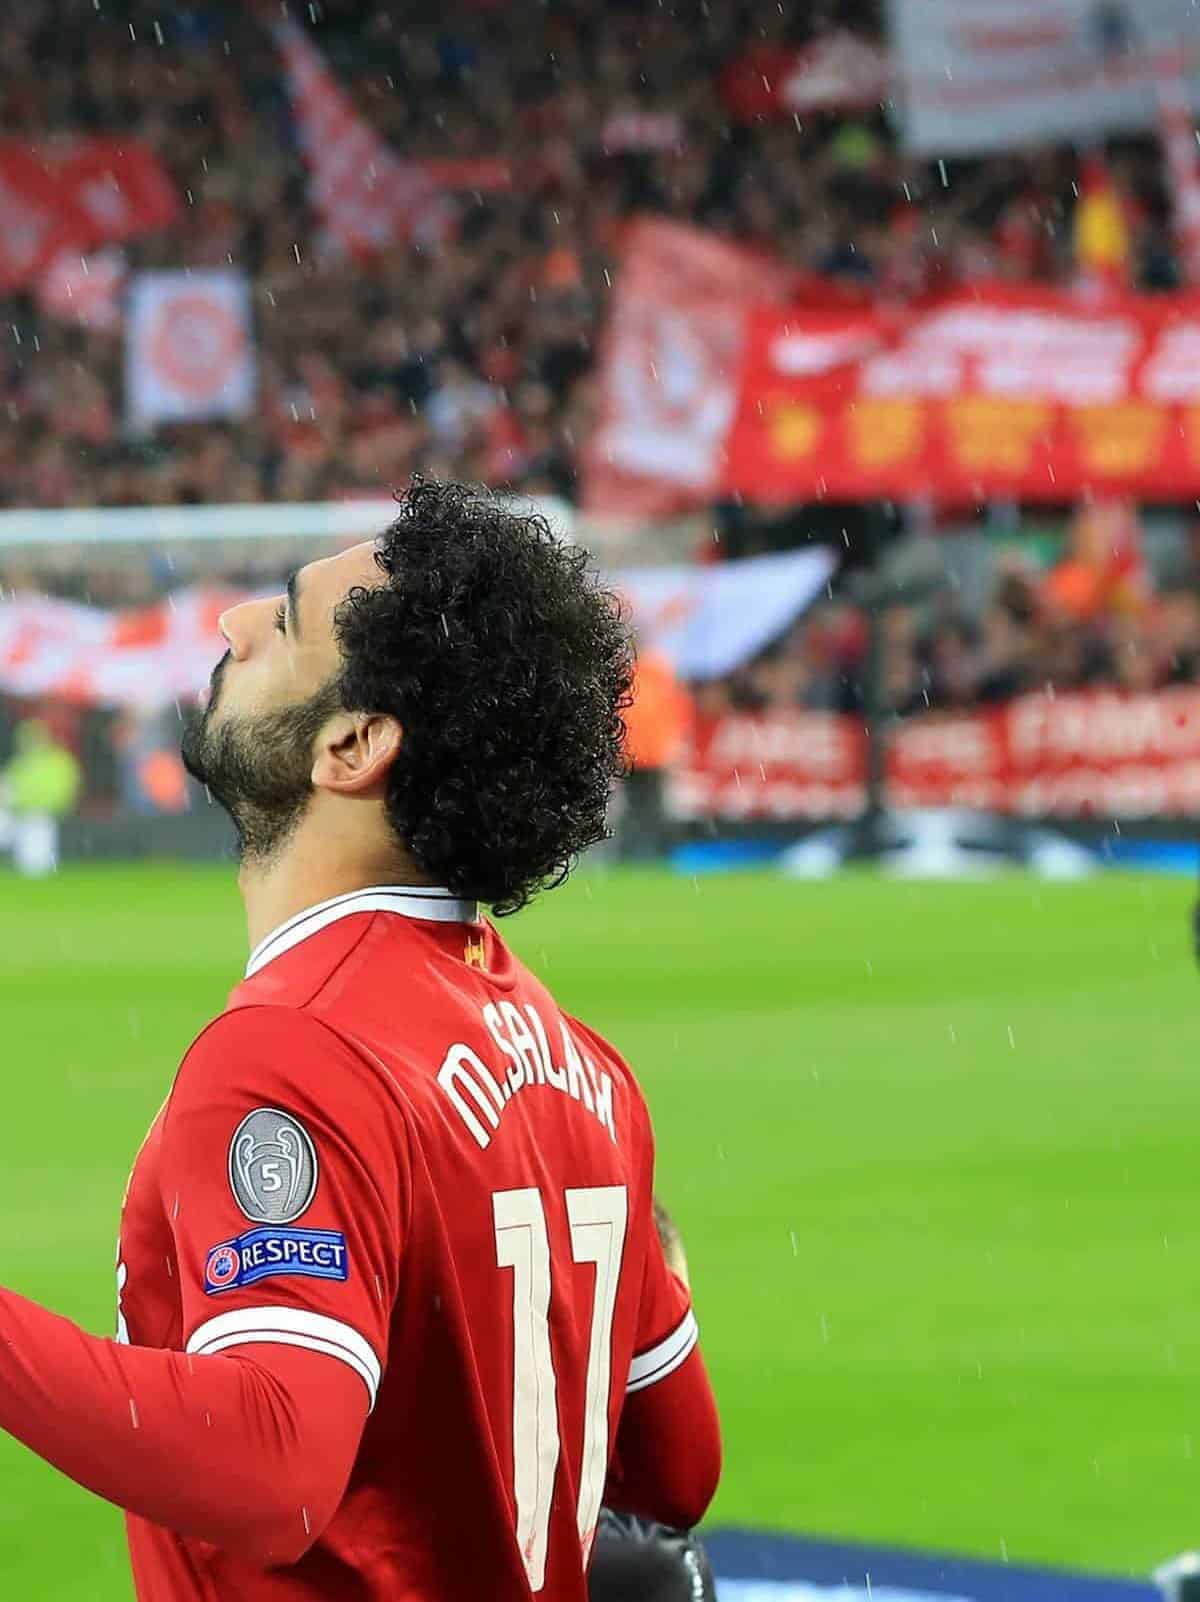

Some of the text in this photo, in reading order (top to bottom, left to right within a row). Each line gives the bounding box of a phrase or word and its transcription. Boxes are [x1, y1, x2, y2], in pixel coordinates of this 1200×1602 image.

[437, 1000, 617, 1150] M.SALAH
[260, 1162, 282, 1192] 5
[242, 1239, 345, 1271] RESPECT
